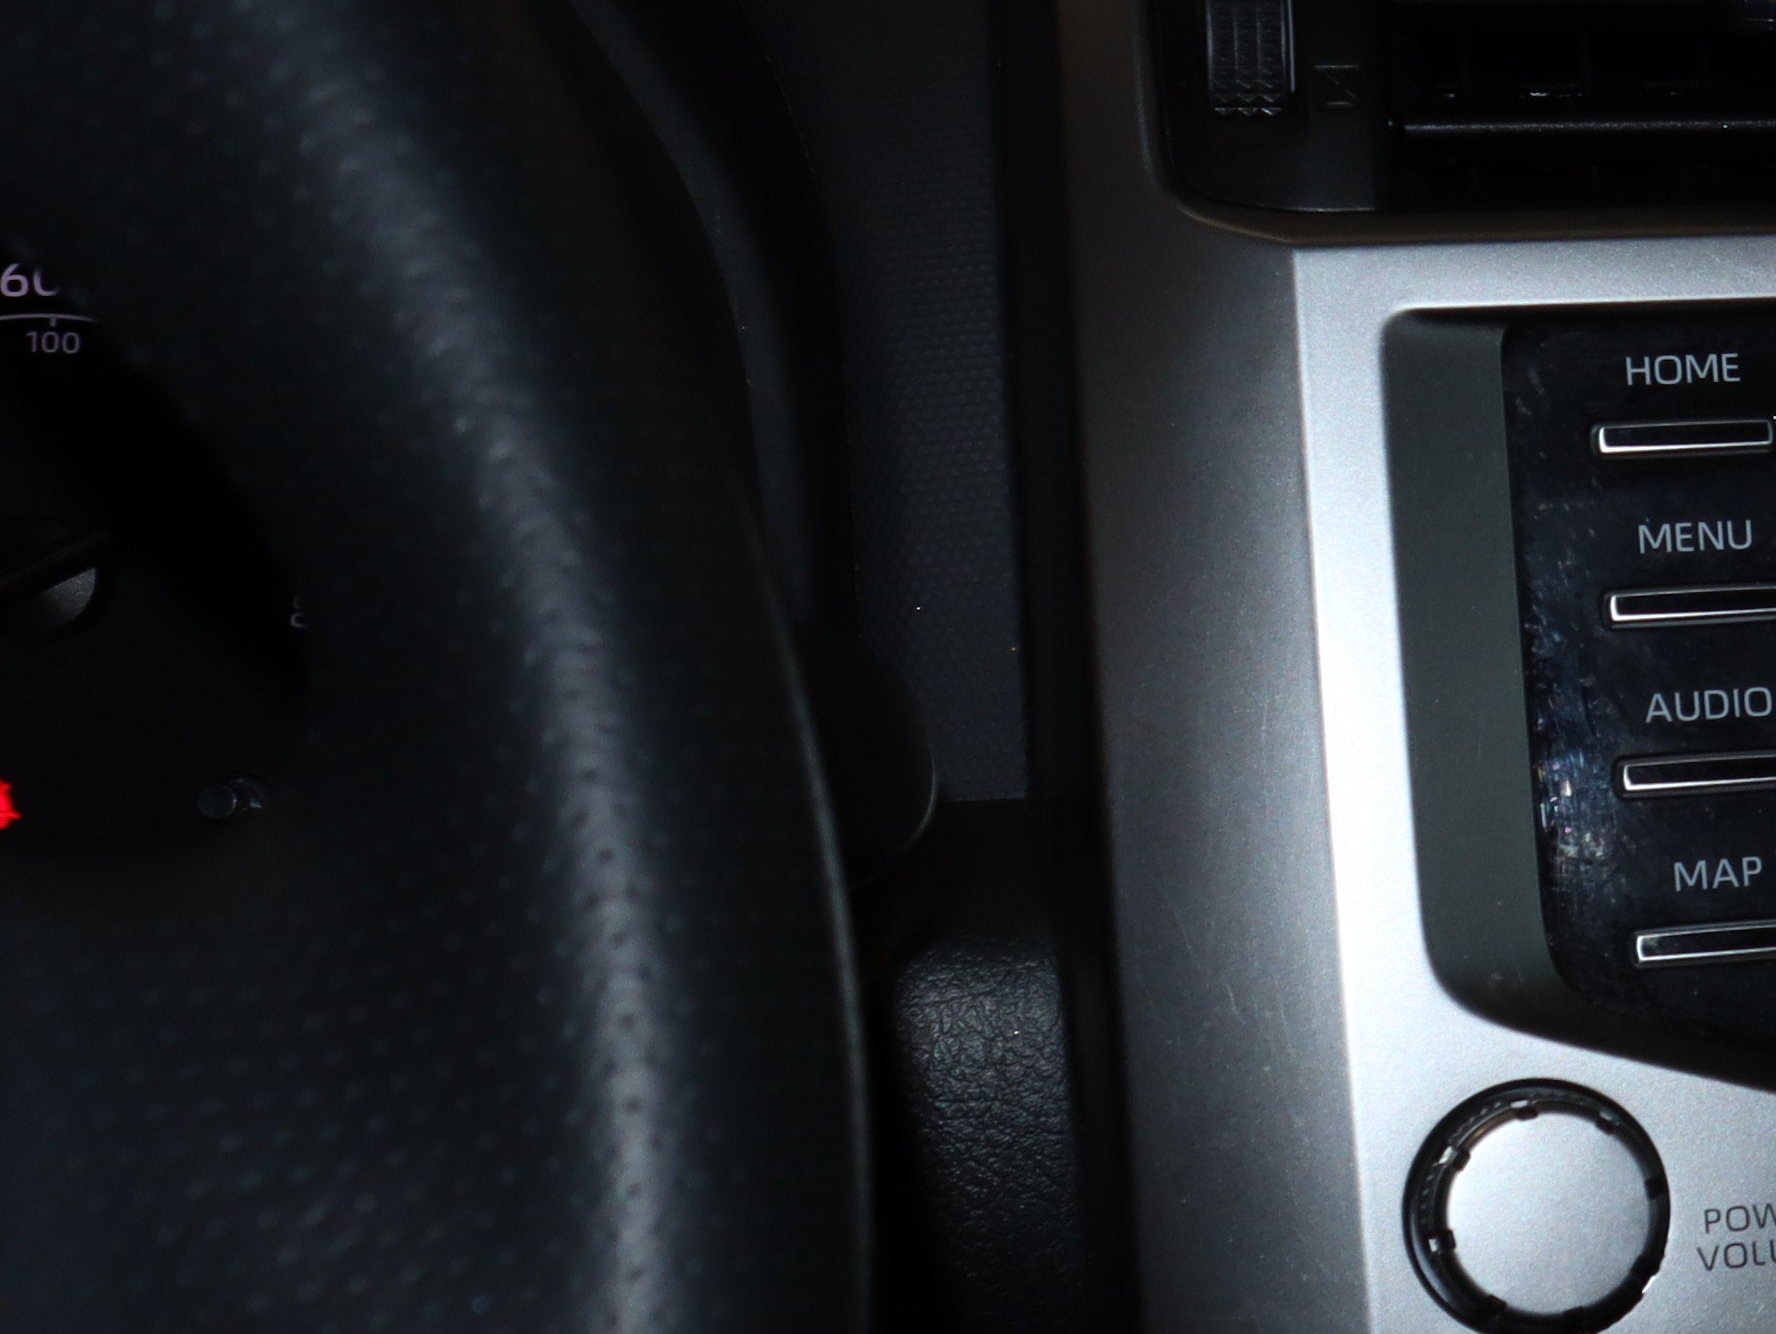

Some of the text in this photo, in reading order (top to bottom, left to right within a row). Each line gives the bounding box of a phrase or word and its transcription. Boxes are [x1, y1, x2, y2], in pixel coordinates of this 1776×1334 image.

[24, 330, 81, 355] 100
[1625, 352, 1742, 386] HOME
[1637, 519, 1753, 555] MENU
[1645, 686, 1774, 724] AUDIO
[1673, 855, 1763, 892] MAP
